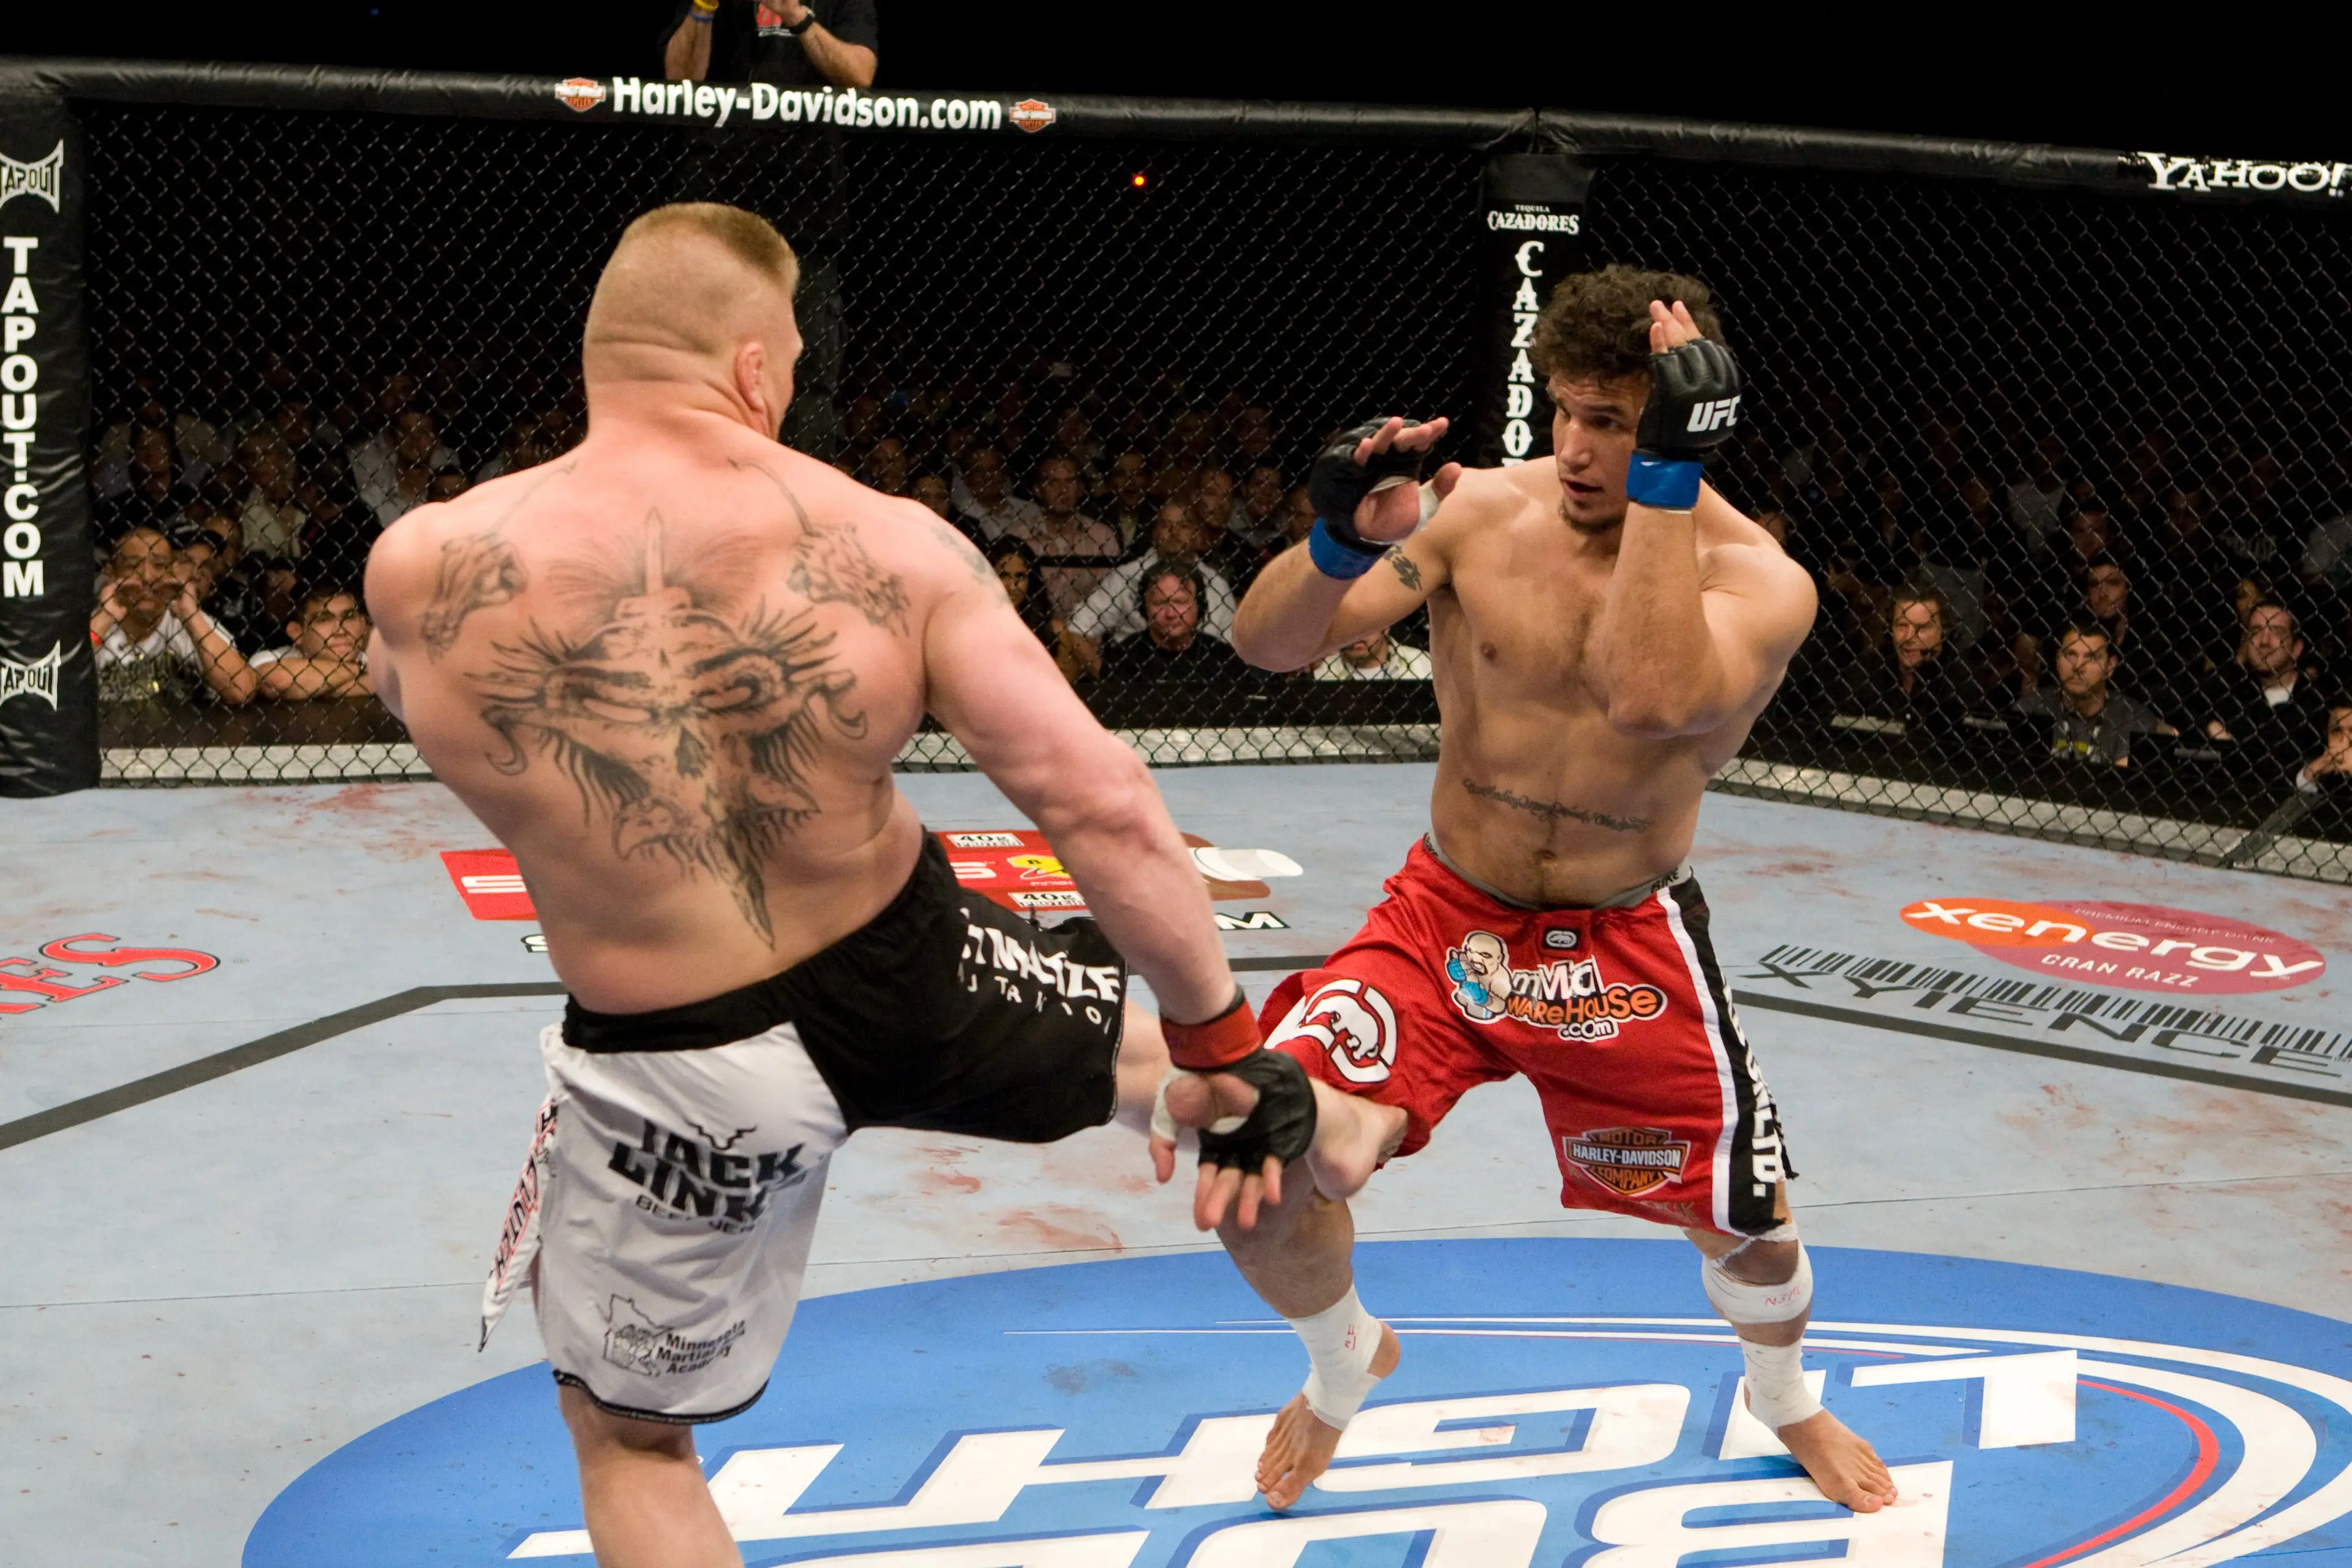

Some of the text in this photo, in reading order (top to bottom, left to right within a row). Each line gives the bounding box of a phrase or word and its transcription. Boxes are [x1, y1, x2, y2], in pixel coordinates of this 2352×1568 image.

[613, 77, 1001, 130] Harley-Davidson.com
[2138, 151, 2345, 197] YAHOO!
[1487, 210, 1580, 235] CAZADORES
[1515, 204, 1550, 213] TEQUILA
[1502, 241, 1544, 467] CAZADO
[1, 236, 44, 598] TAPOUT.COM
[2075, 908, 2150, 927] PREMIUM
[1906, 902, 2324, 979] xenergy
[2041, 954, 2200, 988] CRAN RAZZ
[1737, 956, 2342, 1077] XYIENCE
[1573, 1142, 1681, 1168] HARLEY-DAVIDSON
[1599, 1131, 1659, 1145] MOTOR
[1597, 1165, 1655, 1191] COMPANY
